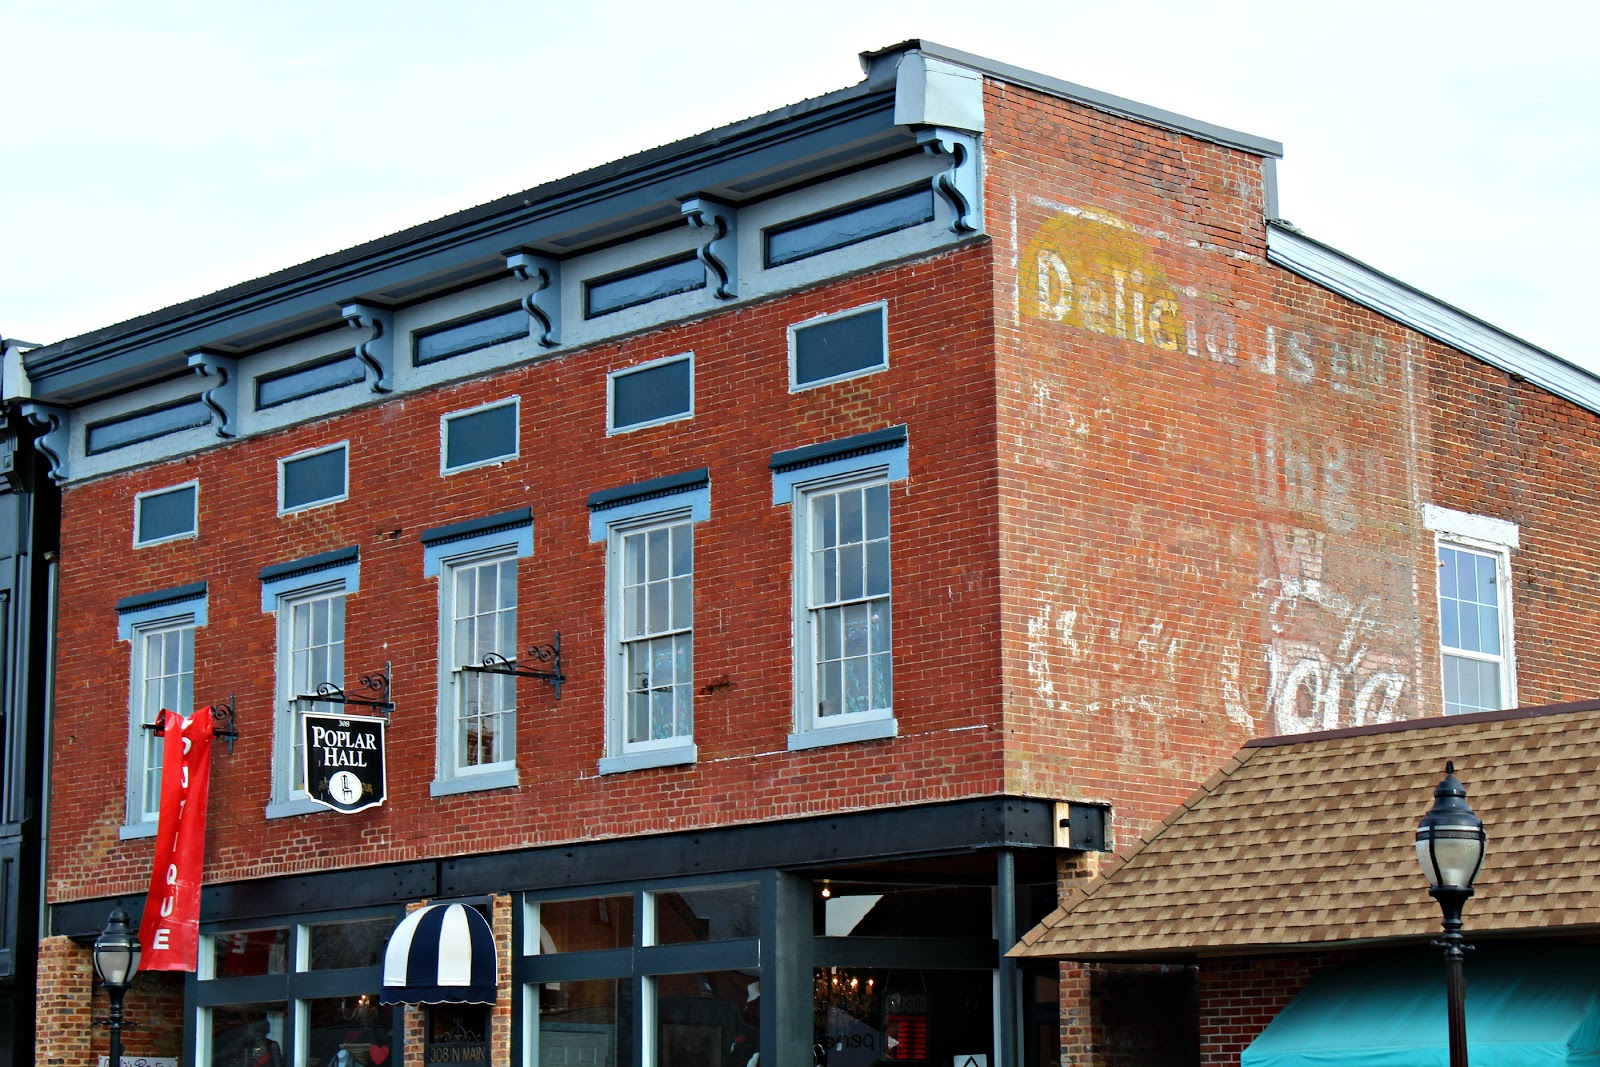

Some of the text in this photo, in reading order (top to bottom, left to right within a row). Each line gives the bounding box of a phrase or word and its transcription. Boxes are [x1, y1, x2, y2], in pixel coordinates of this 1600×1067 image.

[312, 726, 377, 750] POPLAR
[323, 747, 367, 767] HALL
[429, 1046, 485, 1062] 308 N MAIN
